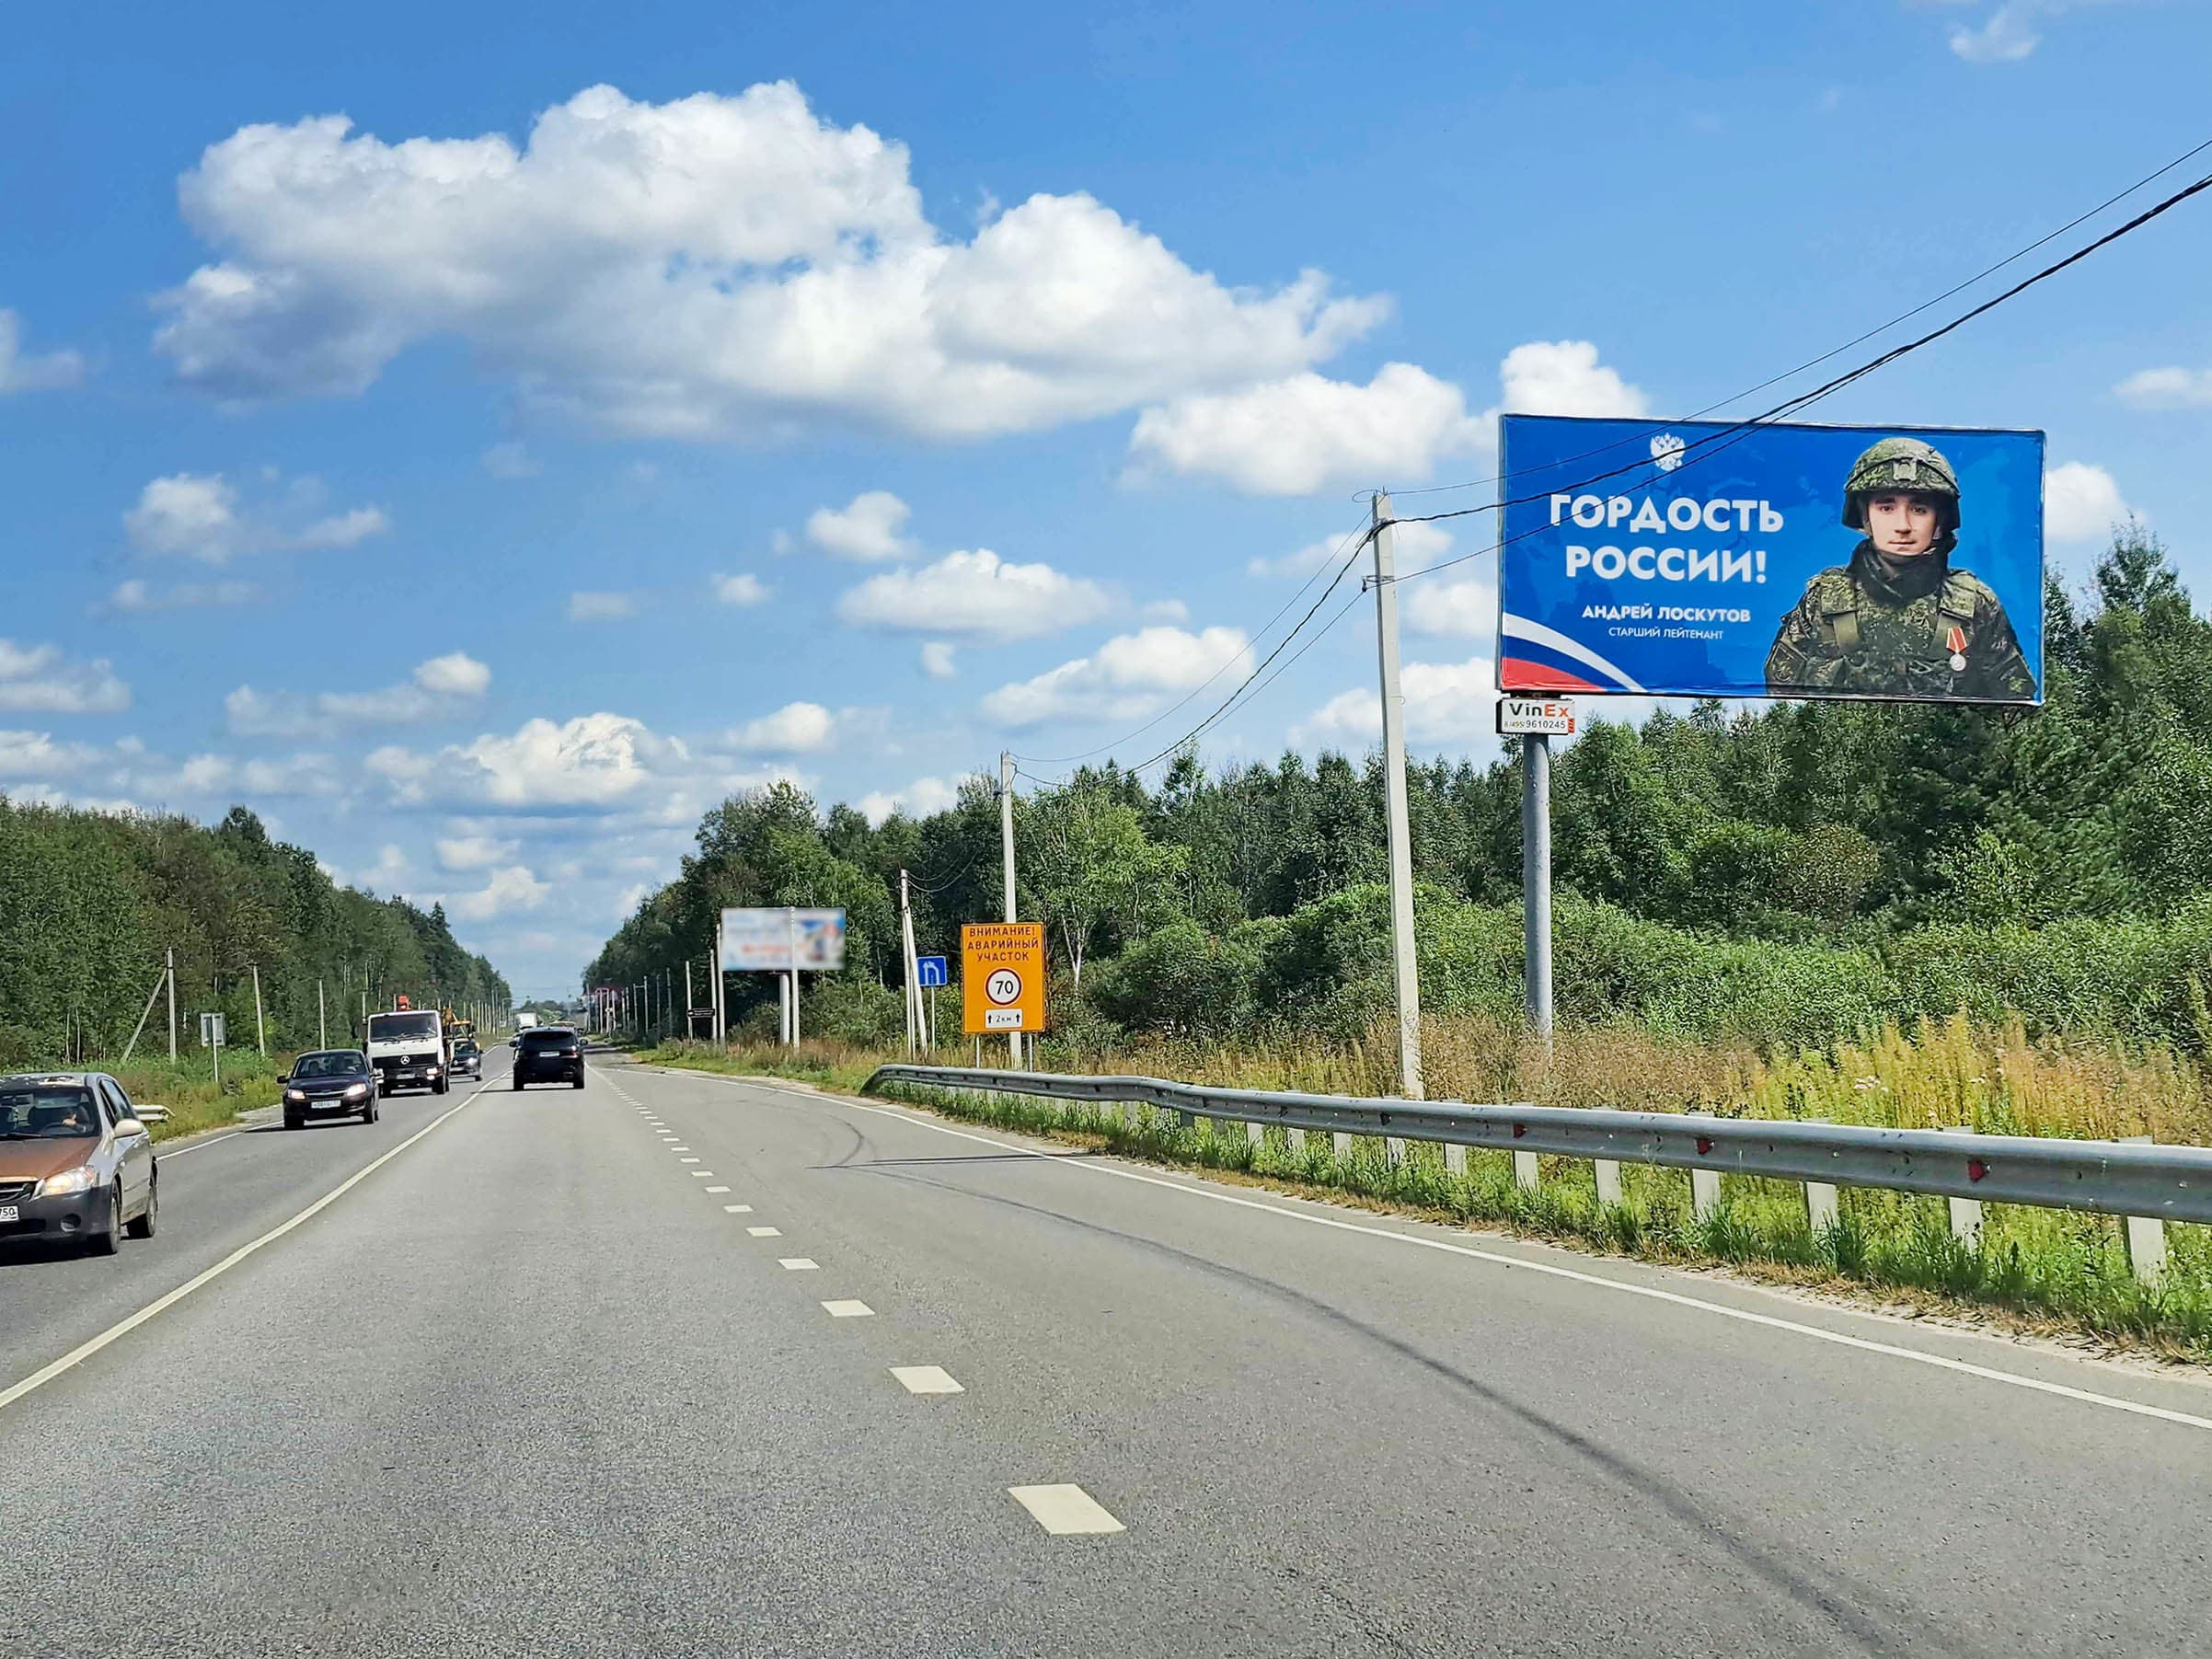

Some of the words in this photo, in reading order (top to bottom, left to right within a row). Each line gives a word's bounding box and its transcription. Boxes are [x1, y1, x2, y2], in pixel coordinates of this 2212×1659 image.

[1550, 493, 1784, 534] ГОРДОСТЬ
[1565, 545, 1767, 584] РОССИИ!
[1582, 603, 1653, 621] АНДРЕЙ
[1657, 606, 1751, 622] ЛОСКУТОВ
[1608, 626, 1660, 638] СТАРШИЙ
[1663, 627, 1724, 639] ЛЕЙТЕНАНТ
[1509, 703, 1568, 718] VinEx
[969, 927, 1035, 937] ВНИМАНИЕ!
[968, 938, 1039, 950] АВАРИЙНЫЙ
[977, 951, 1030, 962] УЧАСТОК
[996, 980, 1013, 995] 70
